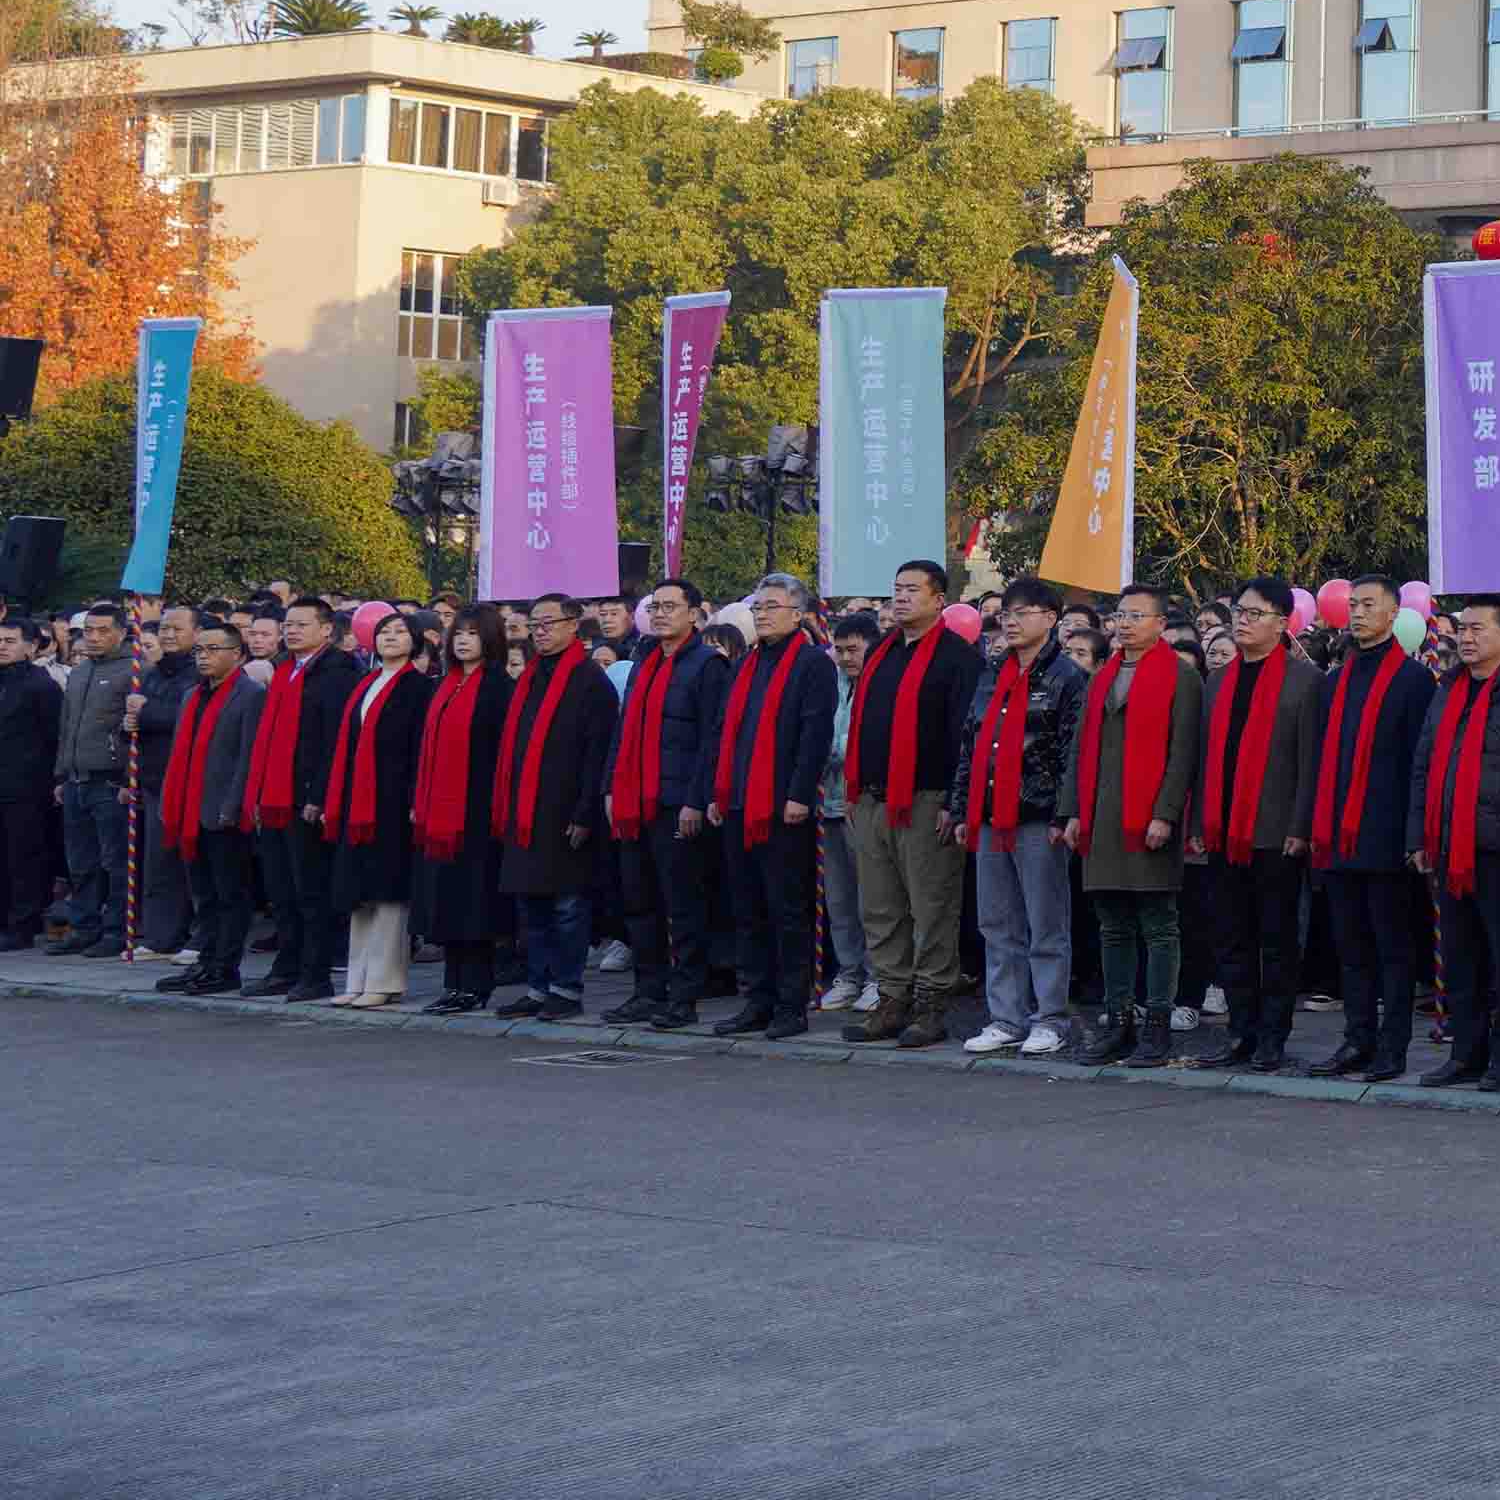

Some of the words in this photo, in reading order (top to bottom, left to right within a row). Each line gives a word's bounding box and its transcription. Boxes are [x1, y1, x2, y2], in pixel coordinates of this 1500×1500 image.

[523, 353, 551, 549] 生产运营中心
[667, 341, 693, 545] 生产运营中心
[860, 335, 889, 545] 生产运营中心
[1466, 360, 1500, 490] 研发部
